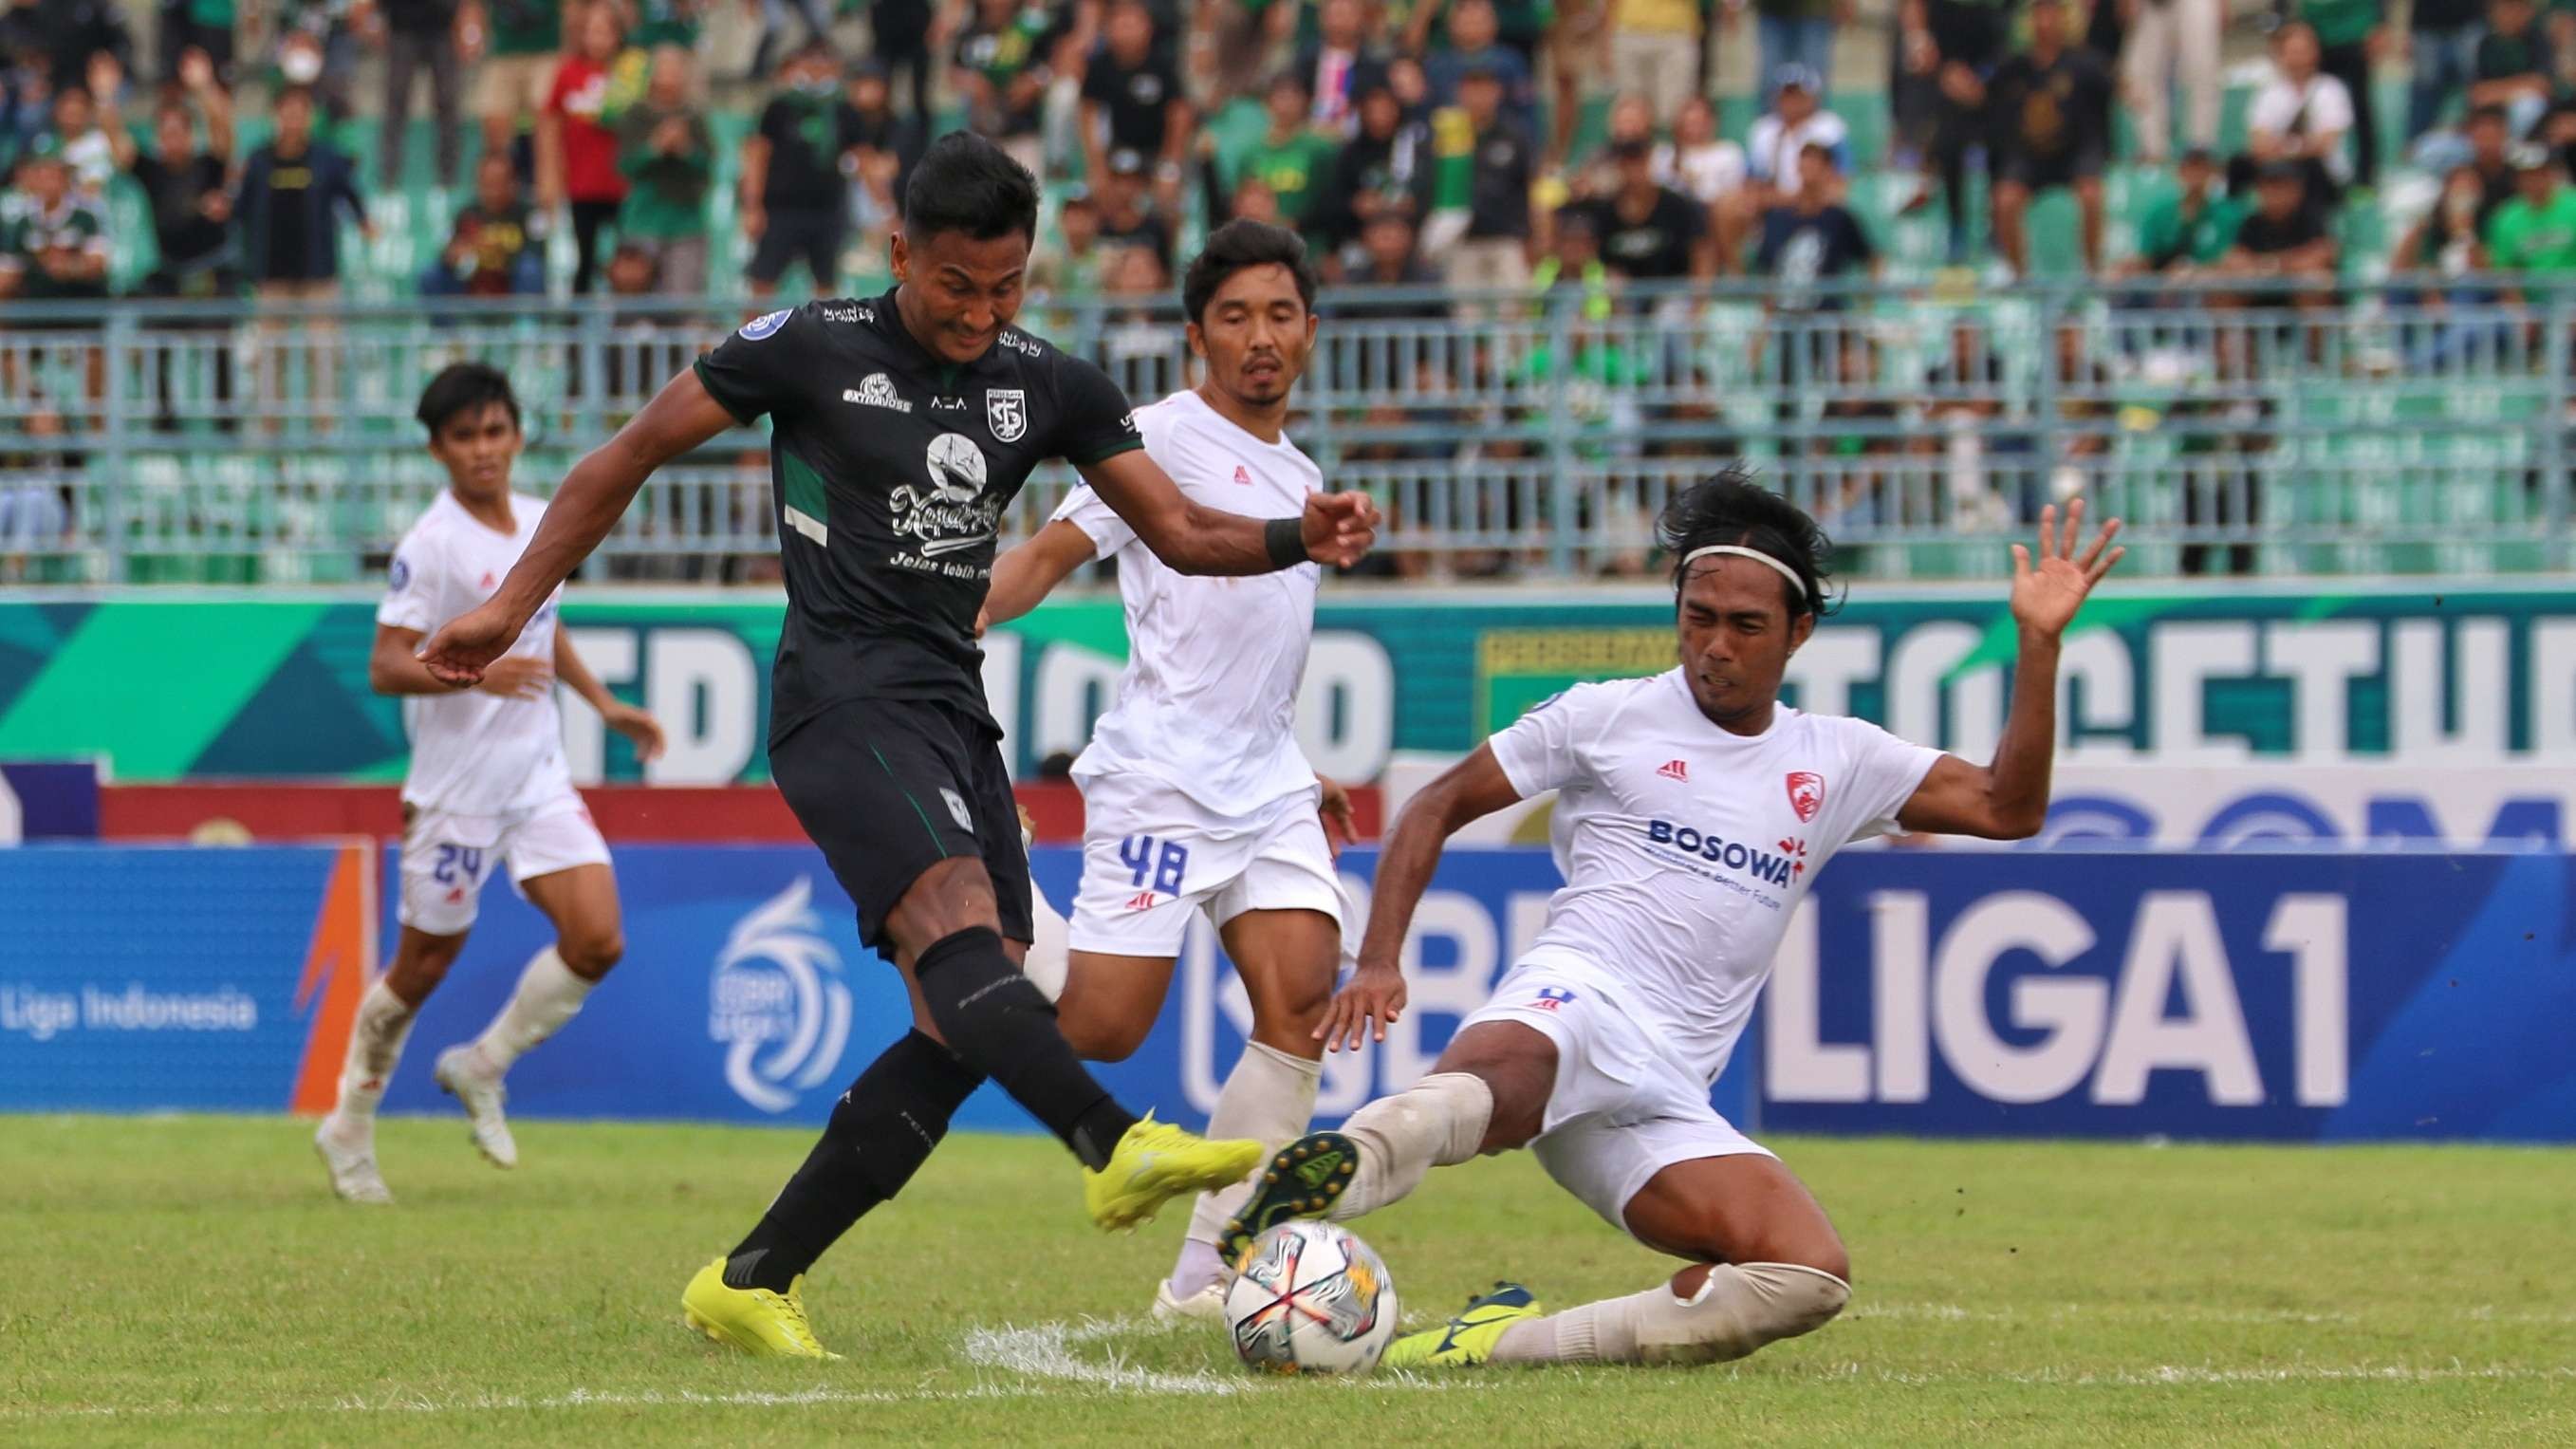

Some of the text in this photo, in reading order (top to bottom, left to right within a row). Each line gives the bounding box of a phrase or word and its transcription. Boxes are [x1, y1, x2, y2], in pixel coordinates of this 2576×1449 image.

[890, 551, 938, 572] Jelas
[943, 561, 974, 580] lebih
[1486, 631, 1677, 666] PERSEBAY
[435, 842, 482, 884] 24
[1120, 834, 1188, 898] 48
[1650, 820, 1791, 889] BOSOWA
[0, 981, 258, 1042] Liga Indonesia
